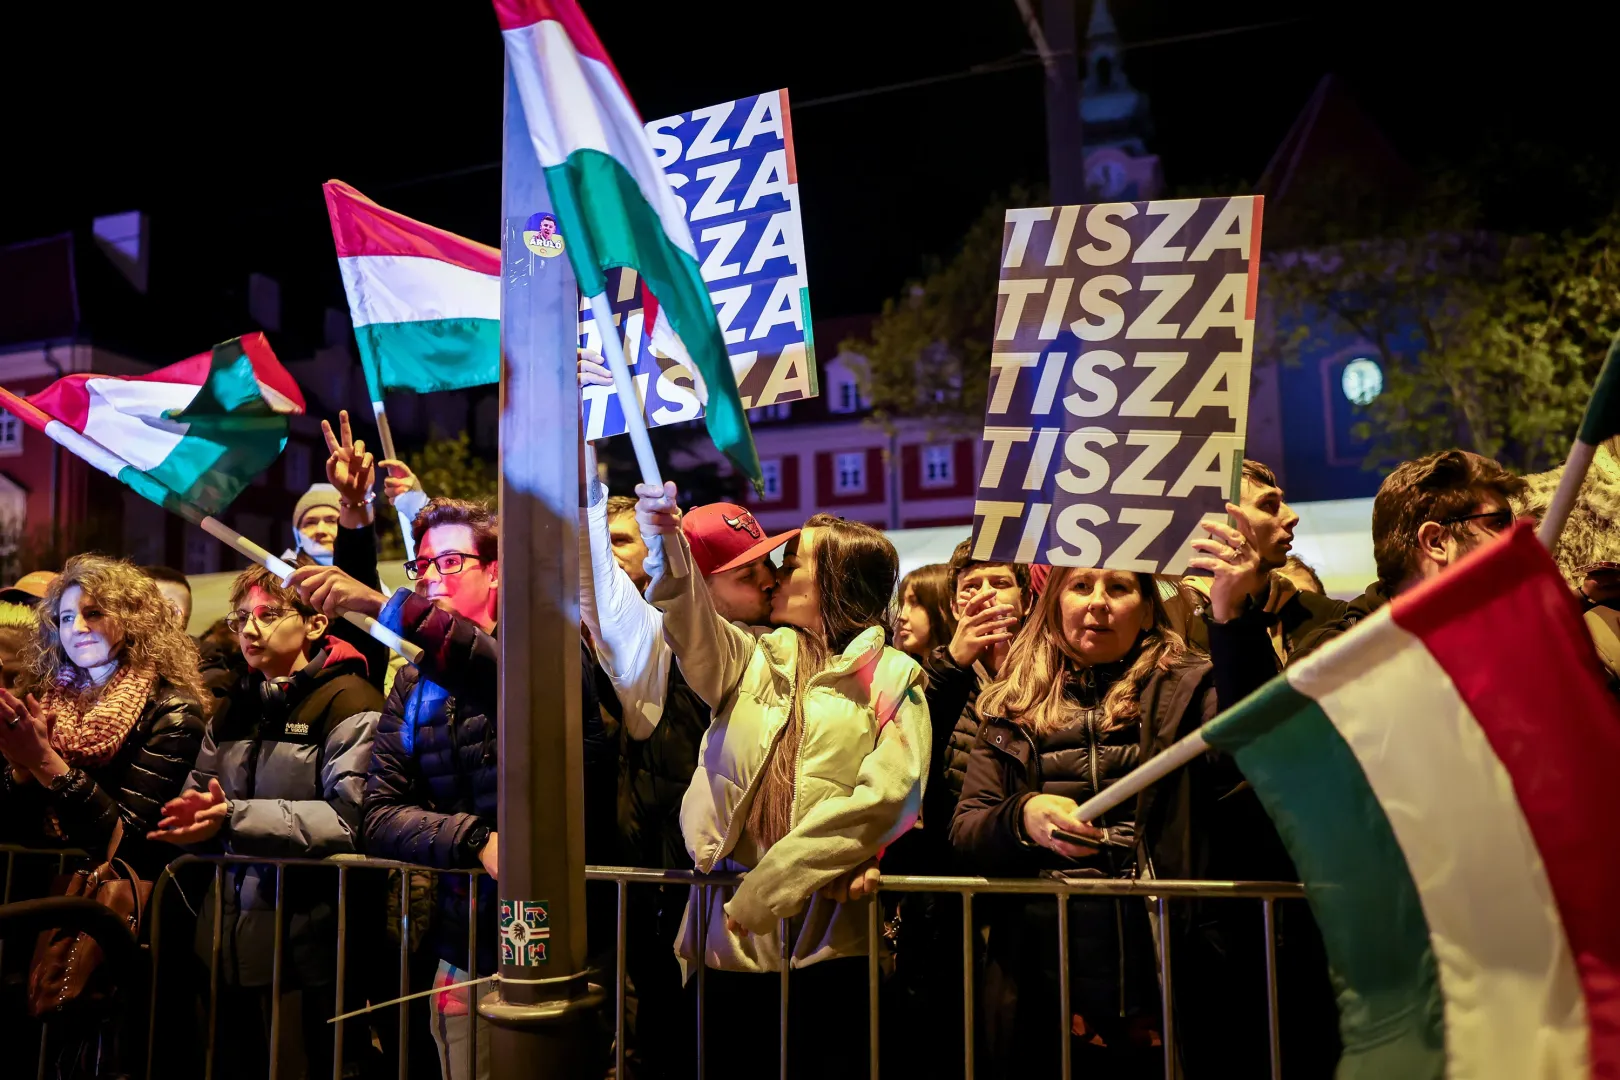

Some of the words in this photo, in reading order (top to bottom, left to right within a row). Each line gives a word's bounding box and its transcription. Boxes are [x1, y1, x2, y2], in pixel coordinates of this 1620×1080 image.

[643, 90, 784, 168] SZA
[1003, 196, 1254, 267] TISZA
[996, 273, 1247, 341] TISZA
[988, 350, 1240, 419] TISZA
[980, 427, 1232, 500] TISZA
[972, 501, 1228, 575] TISZA
